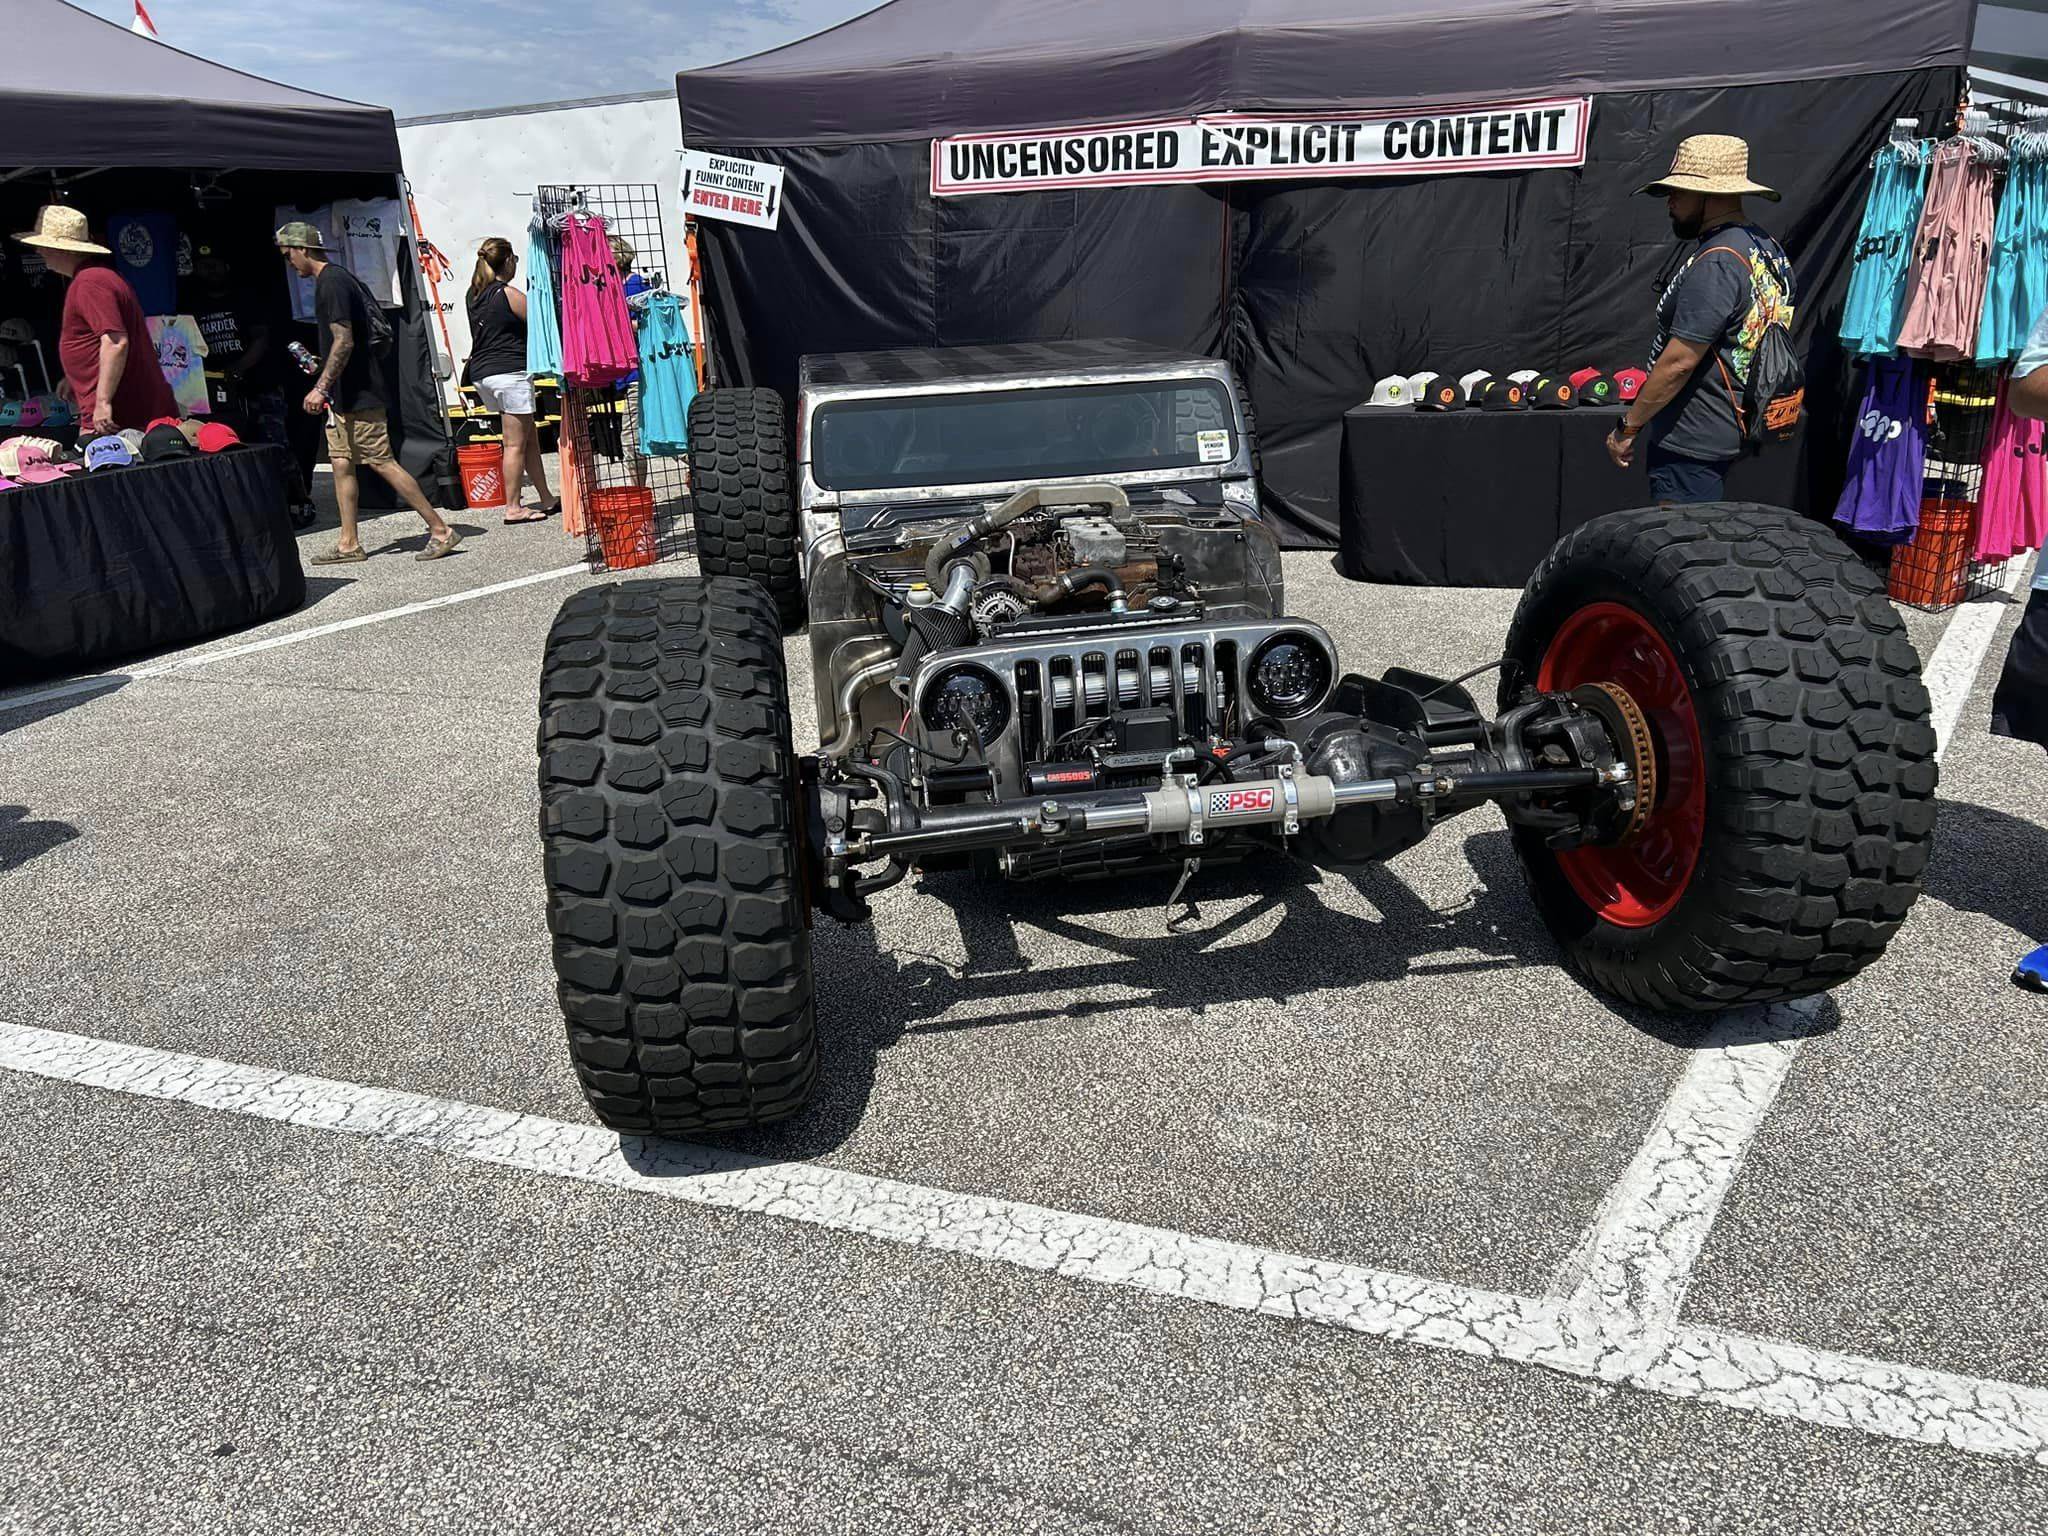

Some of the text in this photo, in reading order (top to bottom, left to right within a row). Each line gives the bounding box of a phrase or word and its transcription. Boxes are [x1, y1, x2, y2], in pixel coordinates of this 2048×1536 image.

[949, 108, 1566, 181] UNCENSORED EXPLICIT CONTENT
[709, 157, 755, 177] EXPLICITLY
[695, 169, 765, 194] FUNNY CONTENT
[693, 188, 763, 217] ENTER HERE
[1229, 789, 1272, 811] PSC
